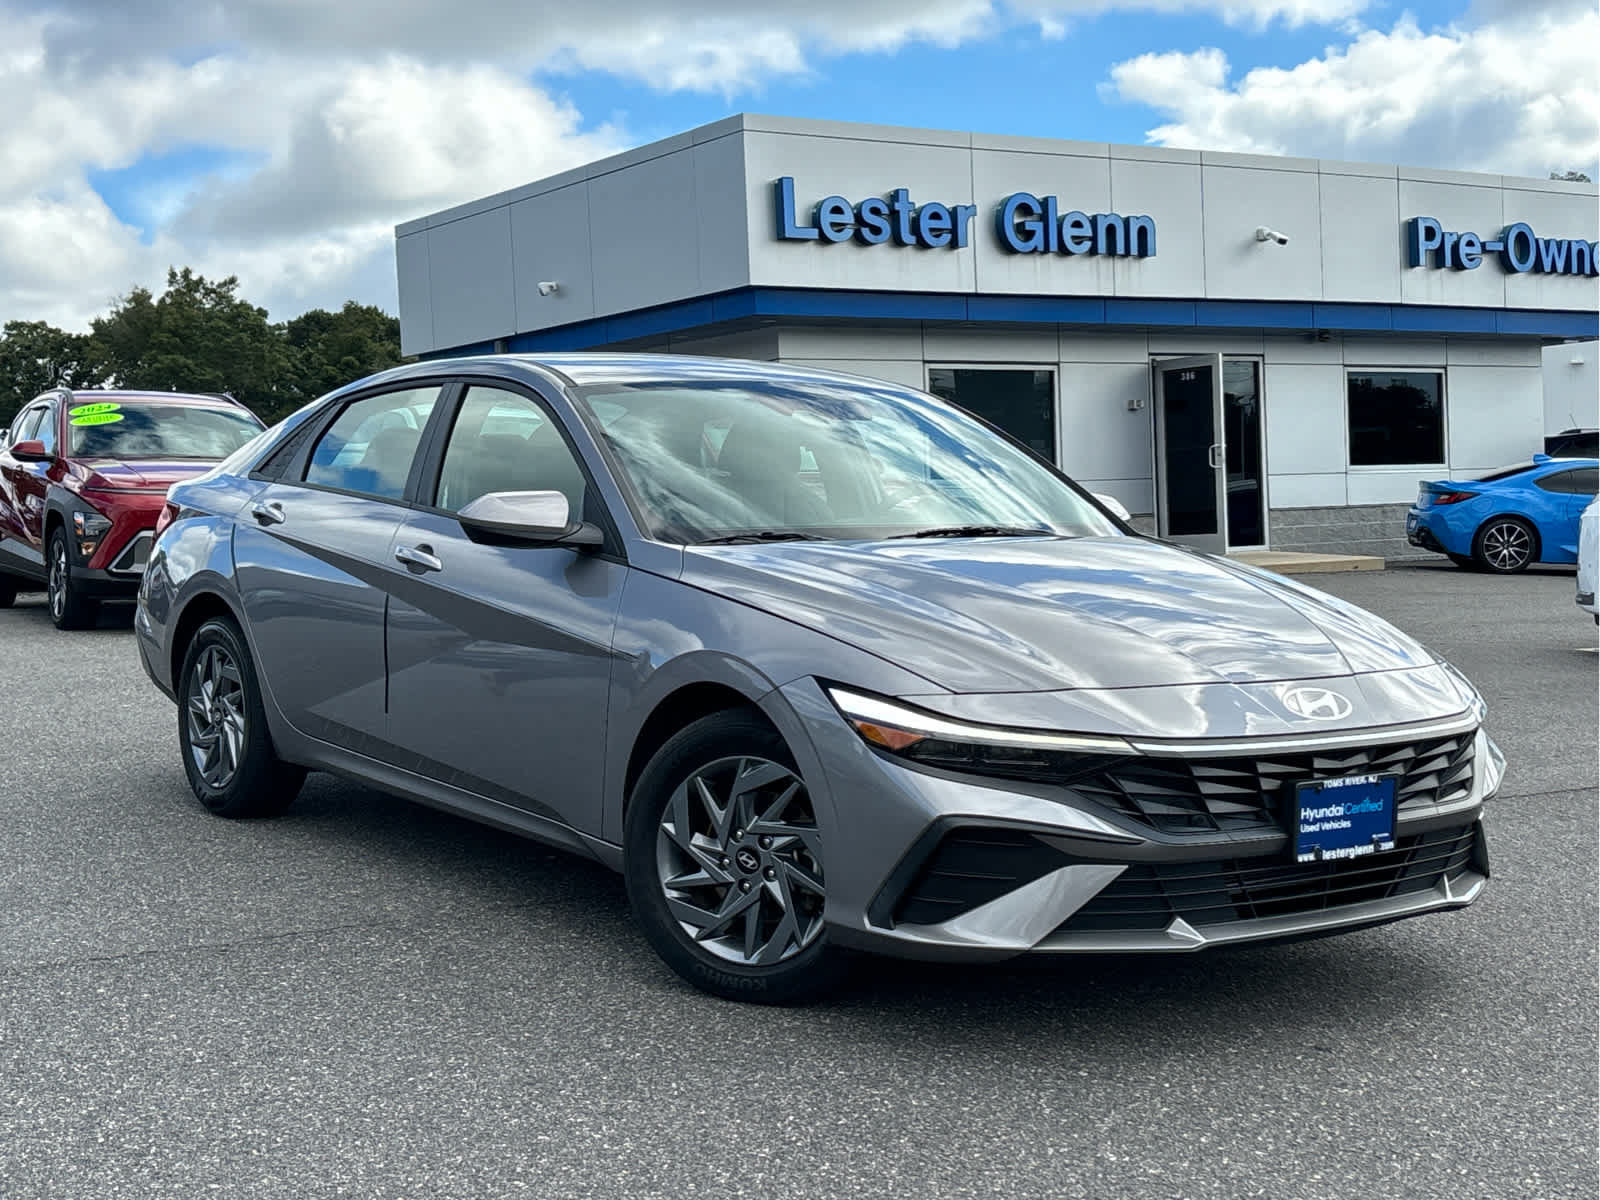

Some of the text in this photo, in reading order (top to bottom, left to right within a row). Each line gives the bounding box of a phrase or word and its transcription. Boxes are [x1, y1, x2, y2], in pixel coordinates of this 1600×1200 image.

[773, 176, 1157, 258] Lester Glenn
[1323, 779, 1344, 789] TOMS
[1300, 820, 1352, 834] Used Vehicles
